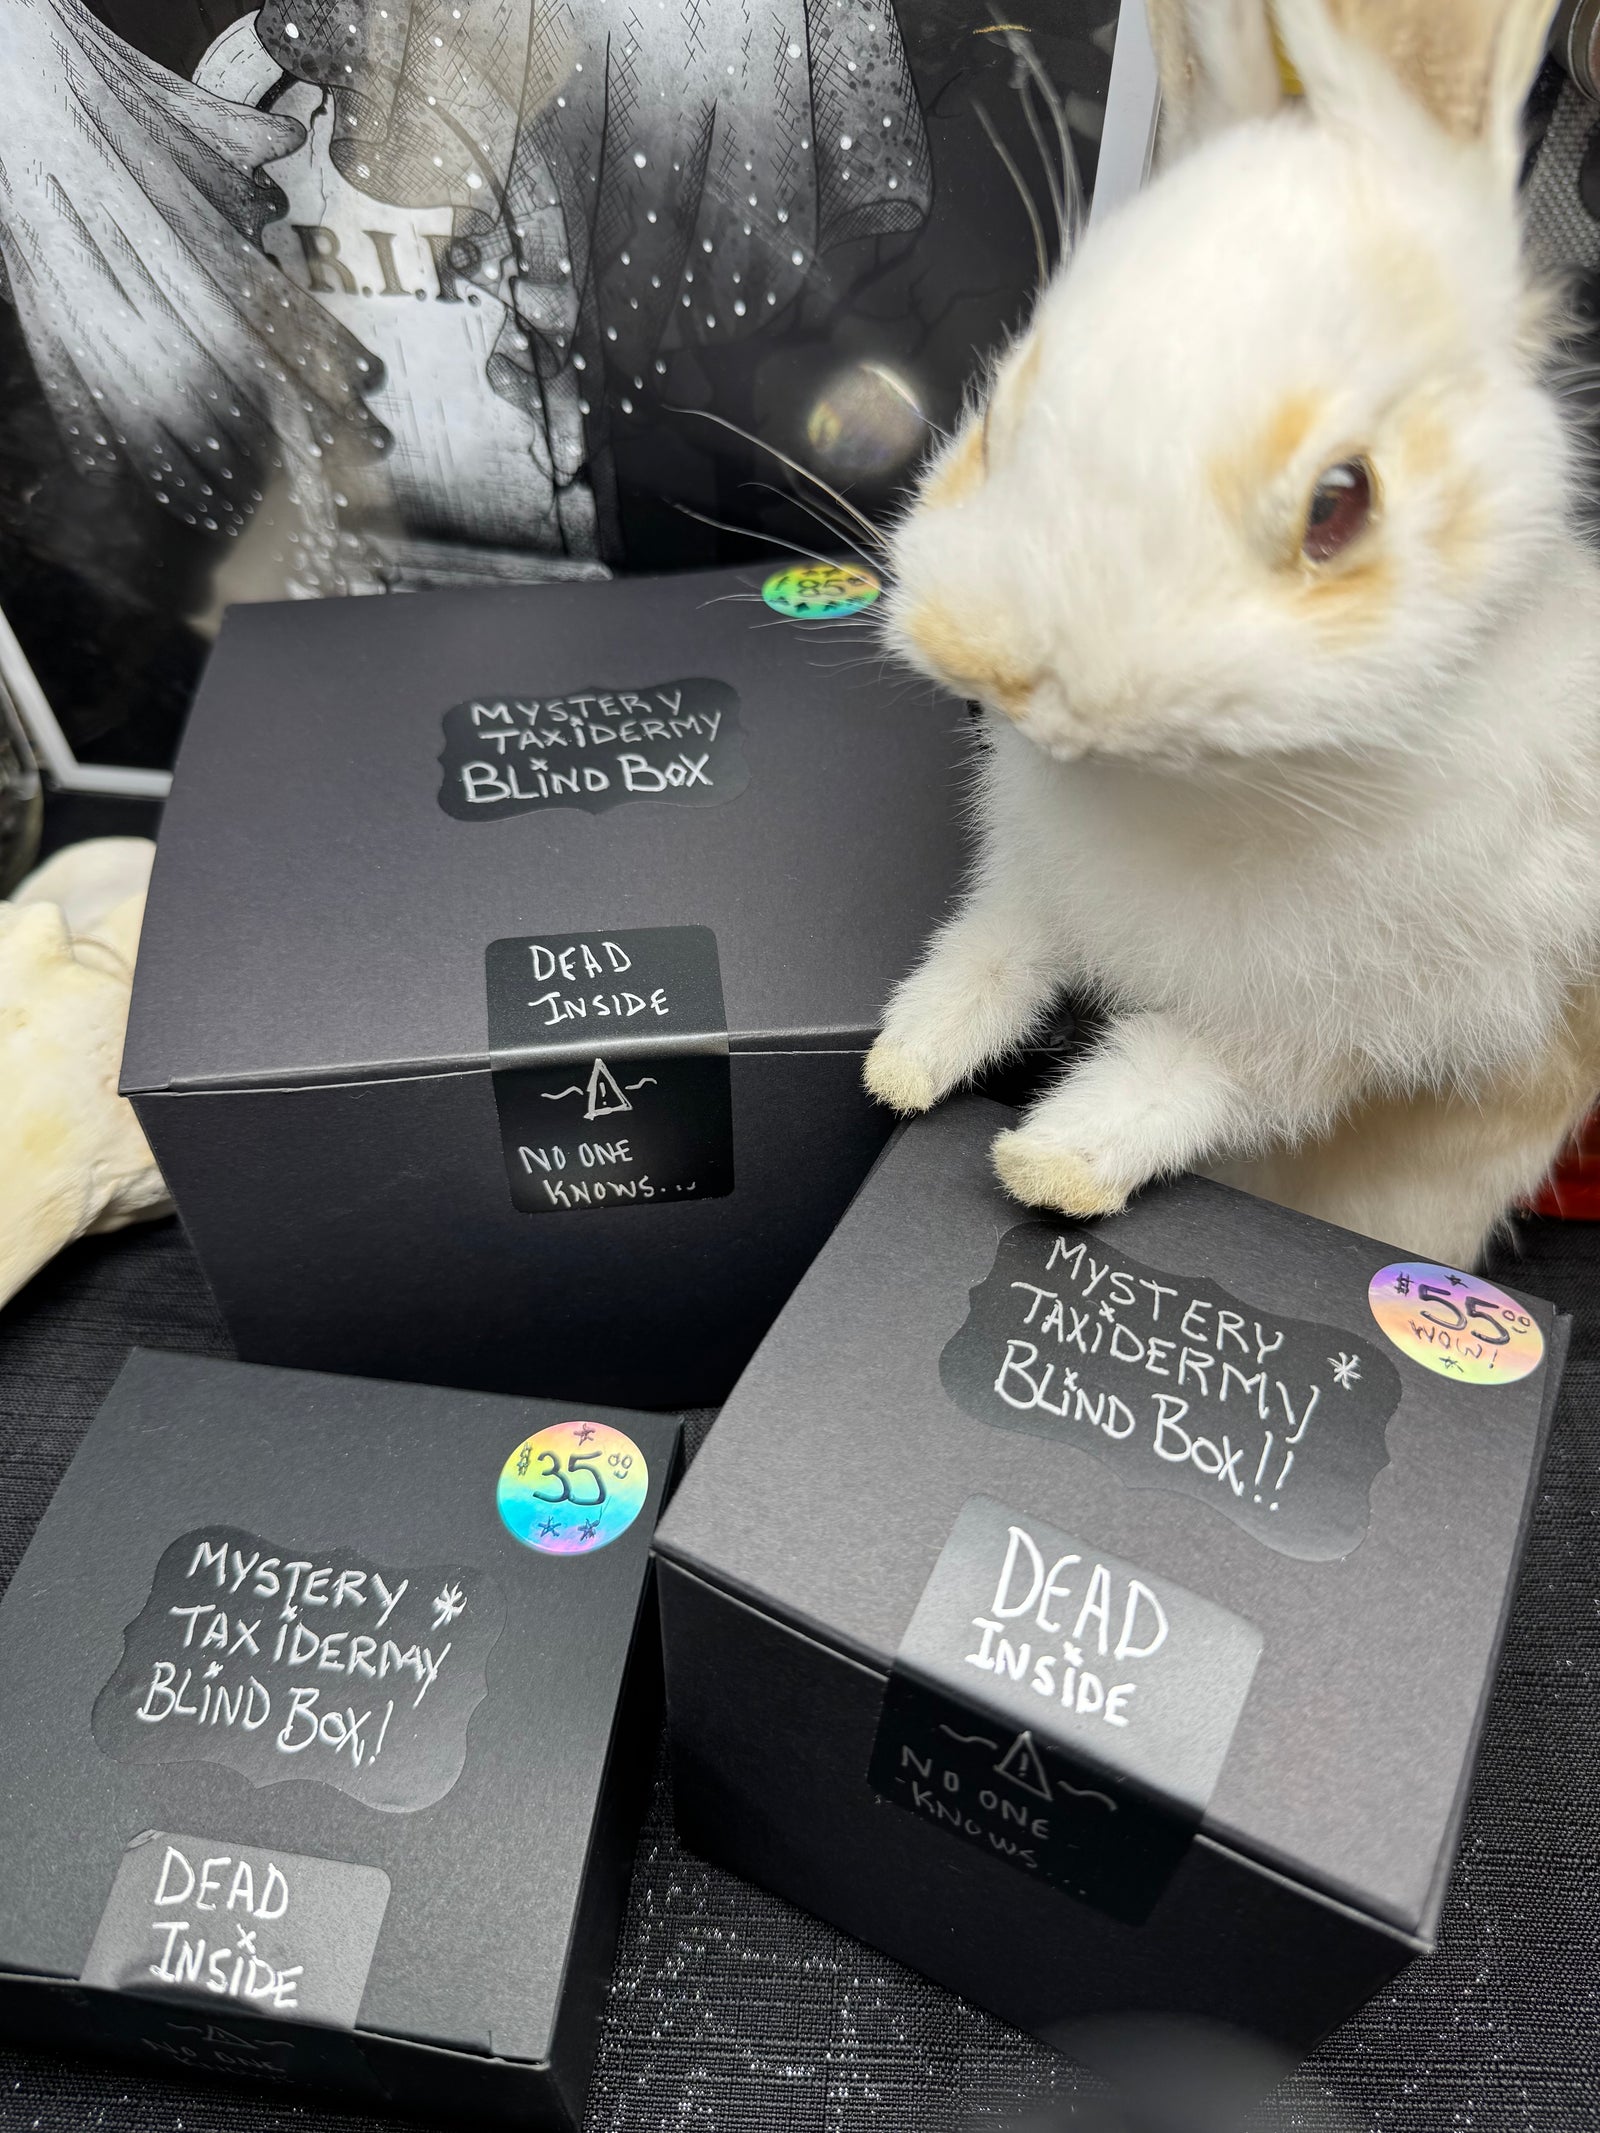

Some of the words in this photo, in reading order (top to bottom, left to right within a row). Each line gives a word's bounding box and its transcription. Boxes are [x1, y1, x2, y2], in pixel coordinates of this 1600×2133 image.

[470, 689, 682, 726] MYSTERY
[529, 942, 632, 981] DEAD
[528, 989, 669, 1025] INSIDE
[518, 1145, 567, 1174] NO
[578, 1139, 633, 1167] ONE
[1045, 1236, 1284, 1364] MYSTERY
[187, 1541, 409, 1629] MYSTERY
[991, 1526, 1169, 1660] DEAD
[901, 1745, 960, 1792] NO
[979, 1790, 1050, 1840] ONE
[154, 1846, 289, 1919] DEAD
